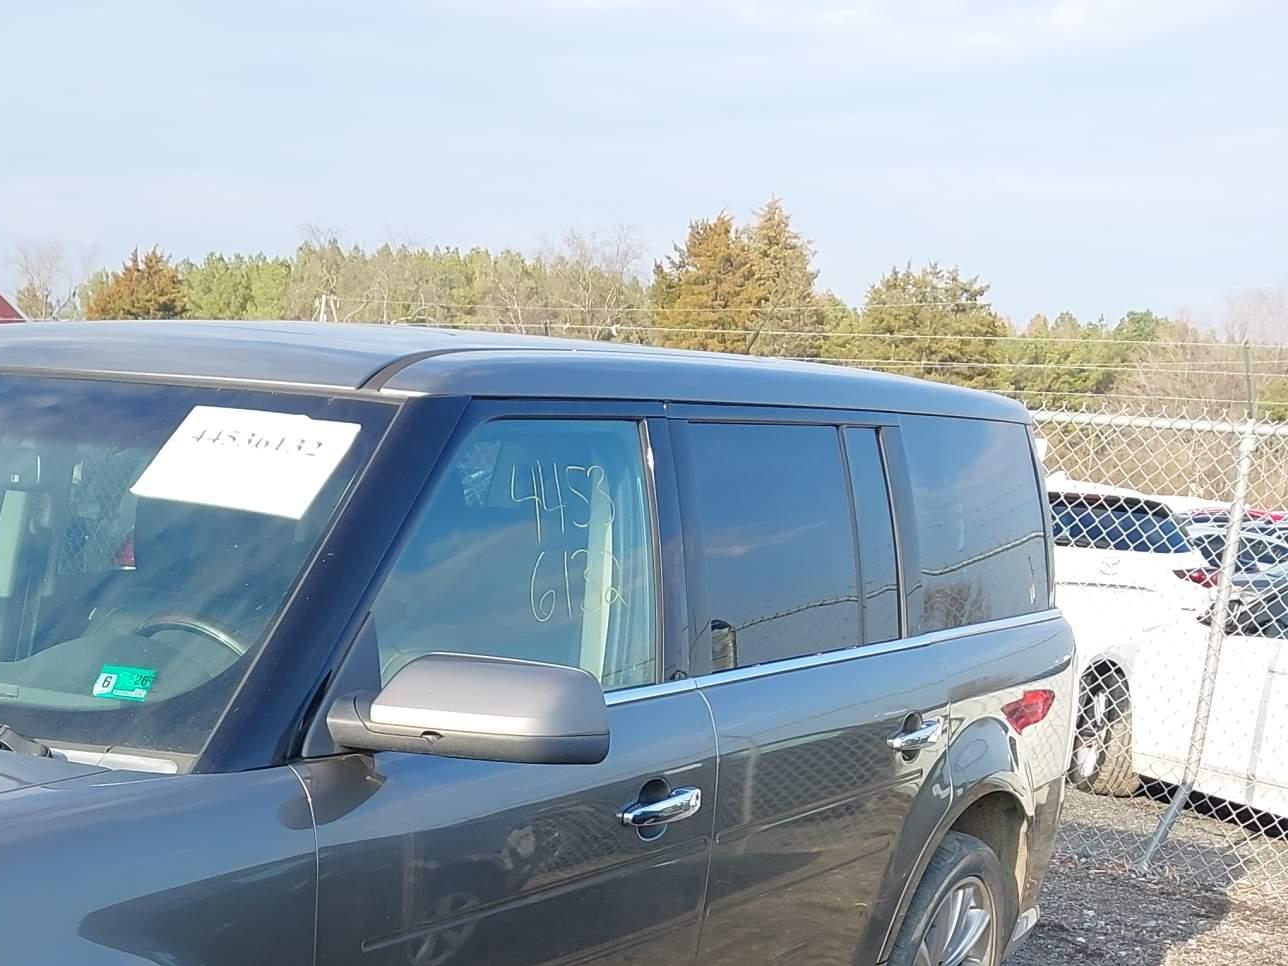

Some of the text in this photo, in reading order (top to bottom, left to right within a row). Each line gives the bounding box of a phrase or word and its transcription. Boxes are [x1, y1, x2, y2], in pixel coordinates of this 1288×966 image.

[511, 459, 616, 544] 4453
[530, 549, 628, 622] 6132
[102, 674, 151, 688] 6 26
